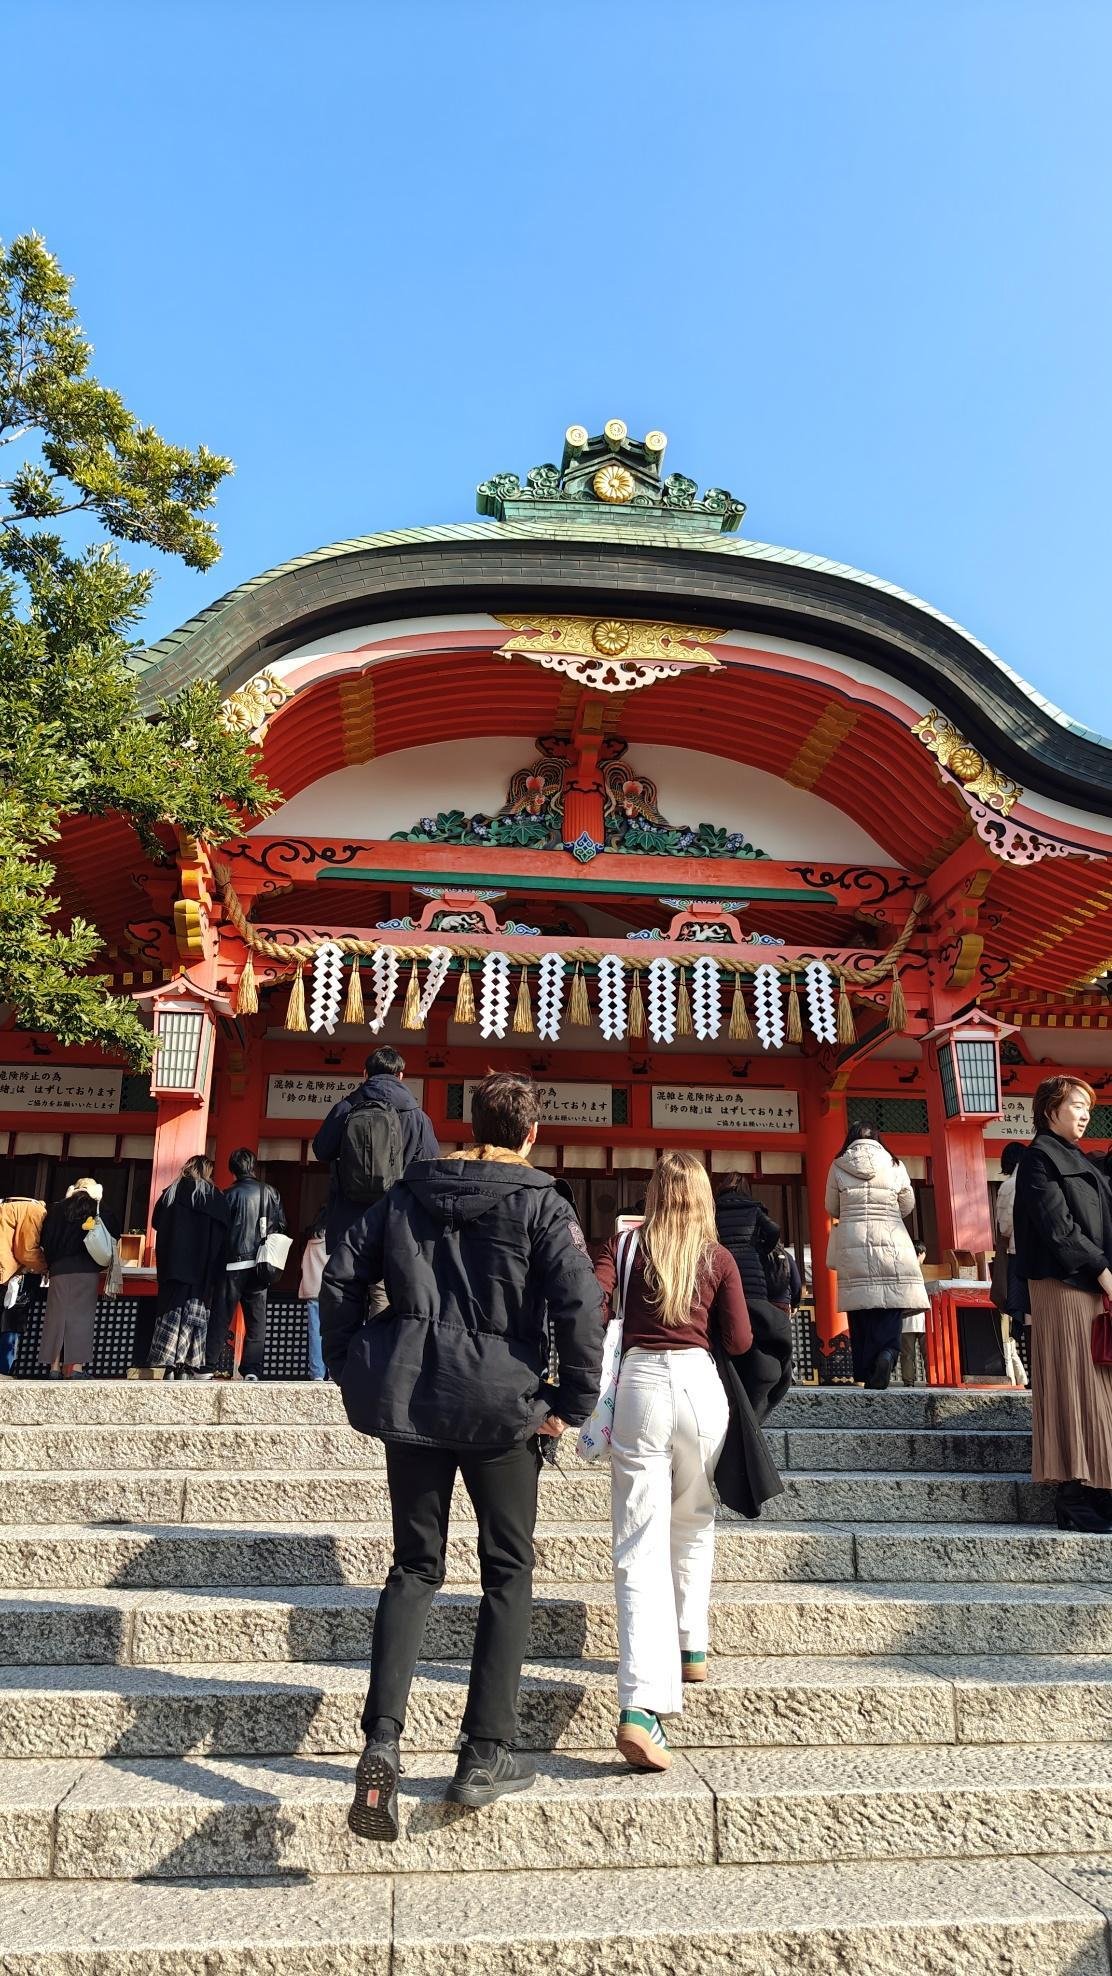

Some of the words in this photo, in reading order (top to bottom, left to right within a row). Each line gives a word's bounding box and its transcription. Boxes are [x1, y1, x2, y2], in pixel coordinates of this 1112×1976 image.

[34, 1085, 116, 1097] はずしております
[656, 1091, 744, 1103] 混雑と危険防止の為
[27, 1099, 115, 1110] ご協力をお願いいたします
[720, 1105, 794, 1117] はずしております
[716, 1119, 794, 1129] ご協力をお願いいたします
